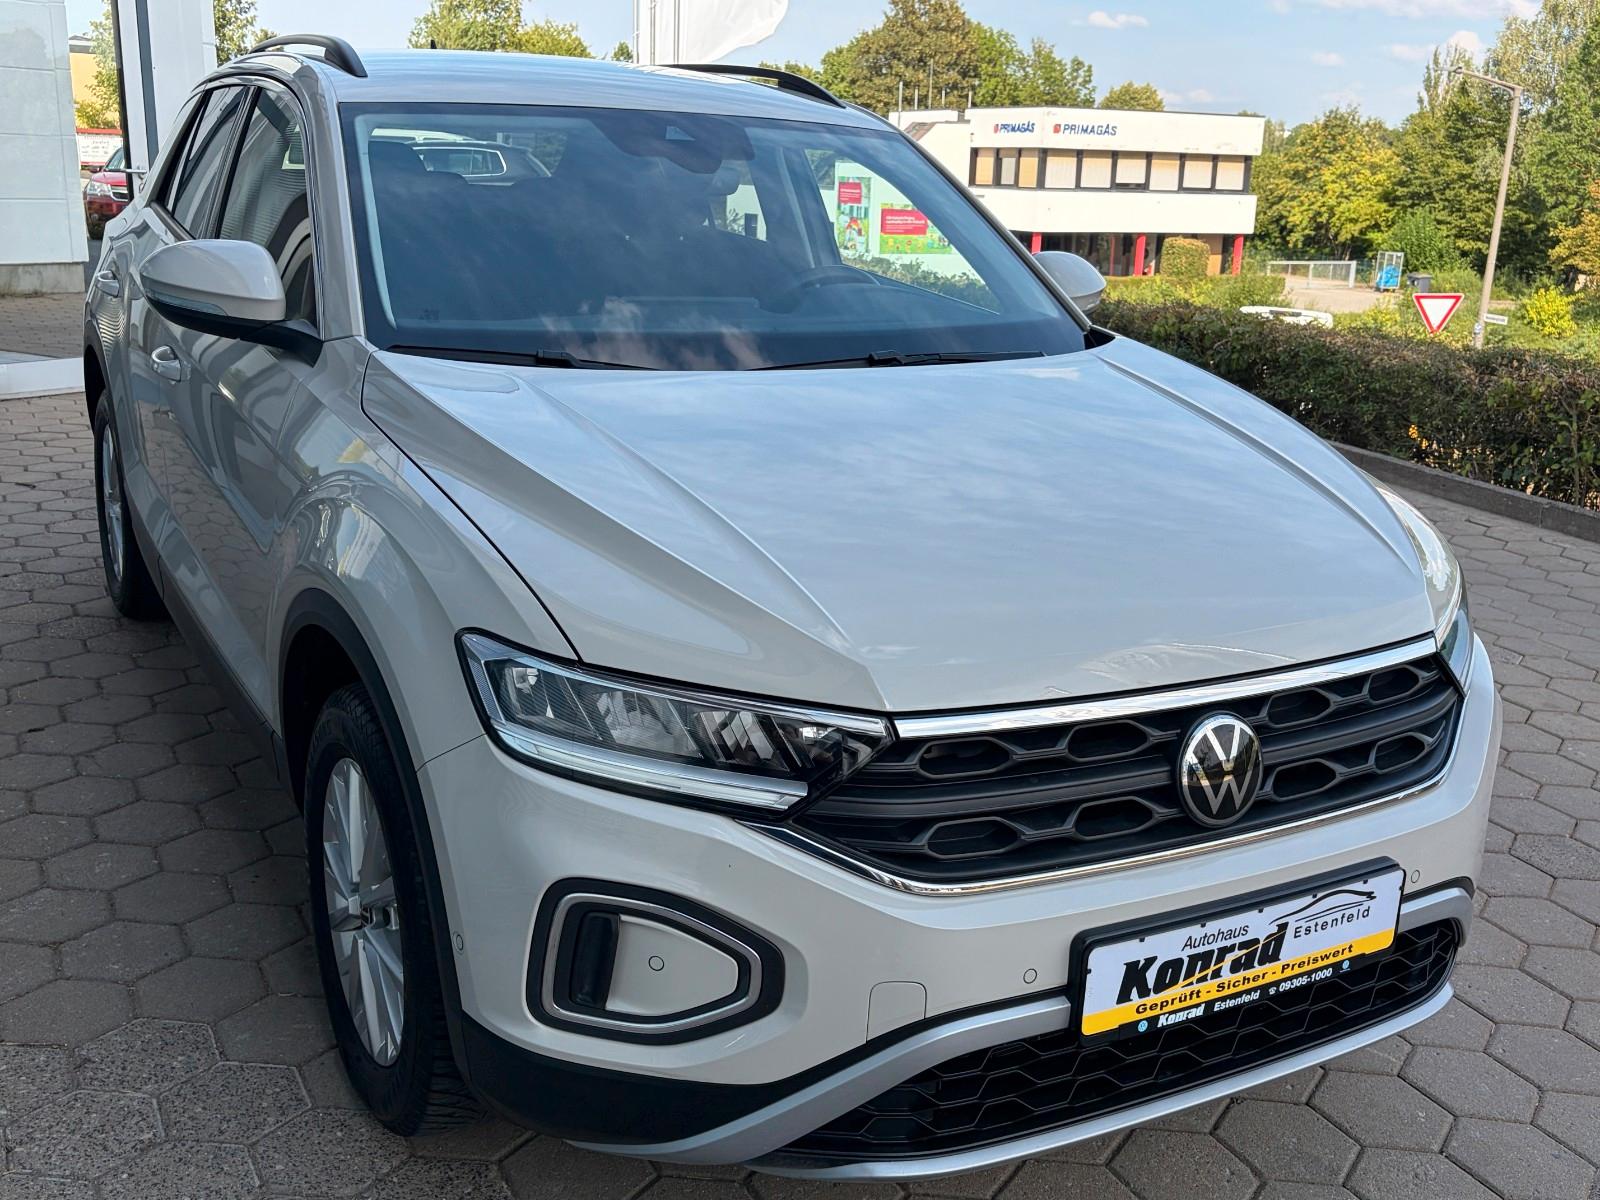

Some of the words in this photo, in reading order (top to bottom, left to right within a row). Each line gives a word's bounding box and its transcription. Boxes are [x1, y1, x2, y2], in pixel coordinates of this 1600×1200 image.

[1062, 123, 1117, 136] PRIMAGAS
[1181, 924, 1249, 951] Autohaus
[1293, 906, 1371, 939] Estenfeld
[1115, 921, 1289, 1005] Konrad
[1135, 988, 1201, 1015] Geprüft
[1215, 972, 1267, 993] Sicher
[1280, 943, 1354, 974] Preiswert
[1157, 1004, 1205, 1028] Konrad
[1213, 990, 1260, 1012] Estenfeld
[1279, 967, 1333, 992] 09305-1000
